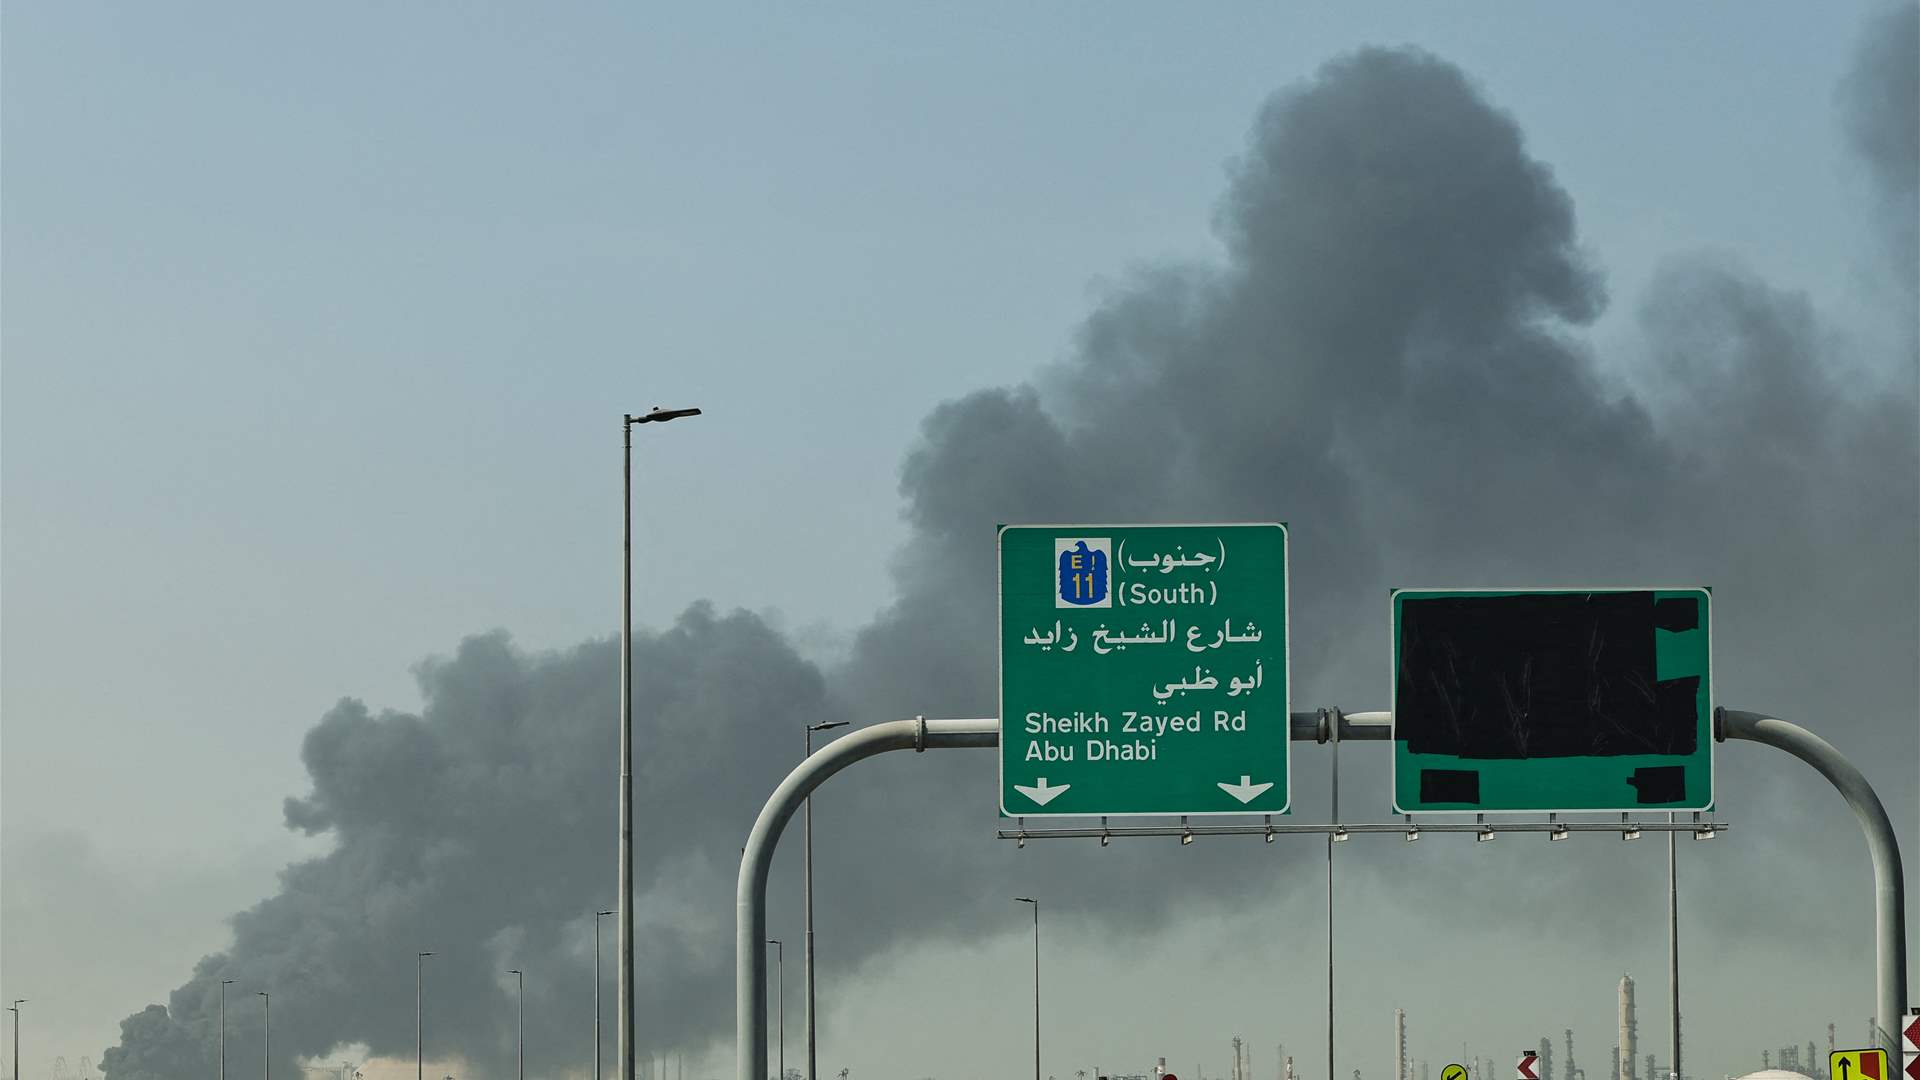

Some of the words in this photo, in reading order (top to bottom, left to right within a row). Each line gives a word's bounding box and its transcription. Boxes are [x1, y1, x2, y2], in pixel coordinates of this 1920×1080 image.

[1071, 555, 1083, 570] E
[1117, 537, 1226, 574] (جنوب)
[1072, 573, 1094, 599] 11
[1118, 581, 1217, 606] (South)
[1024, 619, 1078, 652] زايد
[1092, 618, 1176, 655] الشيخ
[1186, 618, 1263, 652] شارع
[1153, 665, 1219, 706] ظبي
[1226, 658, 1263, 697] أبو
[1025, 711, 1109, 734] Sheikh
[1122, 711, 1201, 737] Zayed
[1214, 710, 1246, 732] Rd
[1025, 740, 1074, 762] Abu
[1086, 739, 1157, 761] Dhabi
